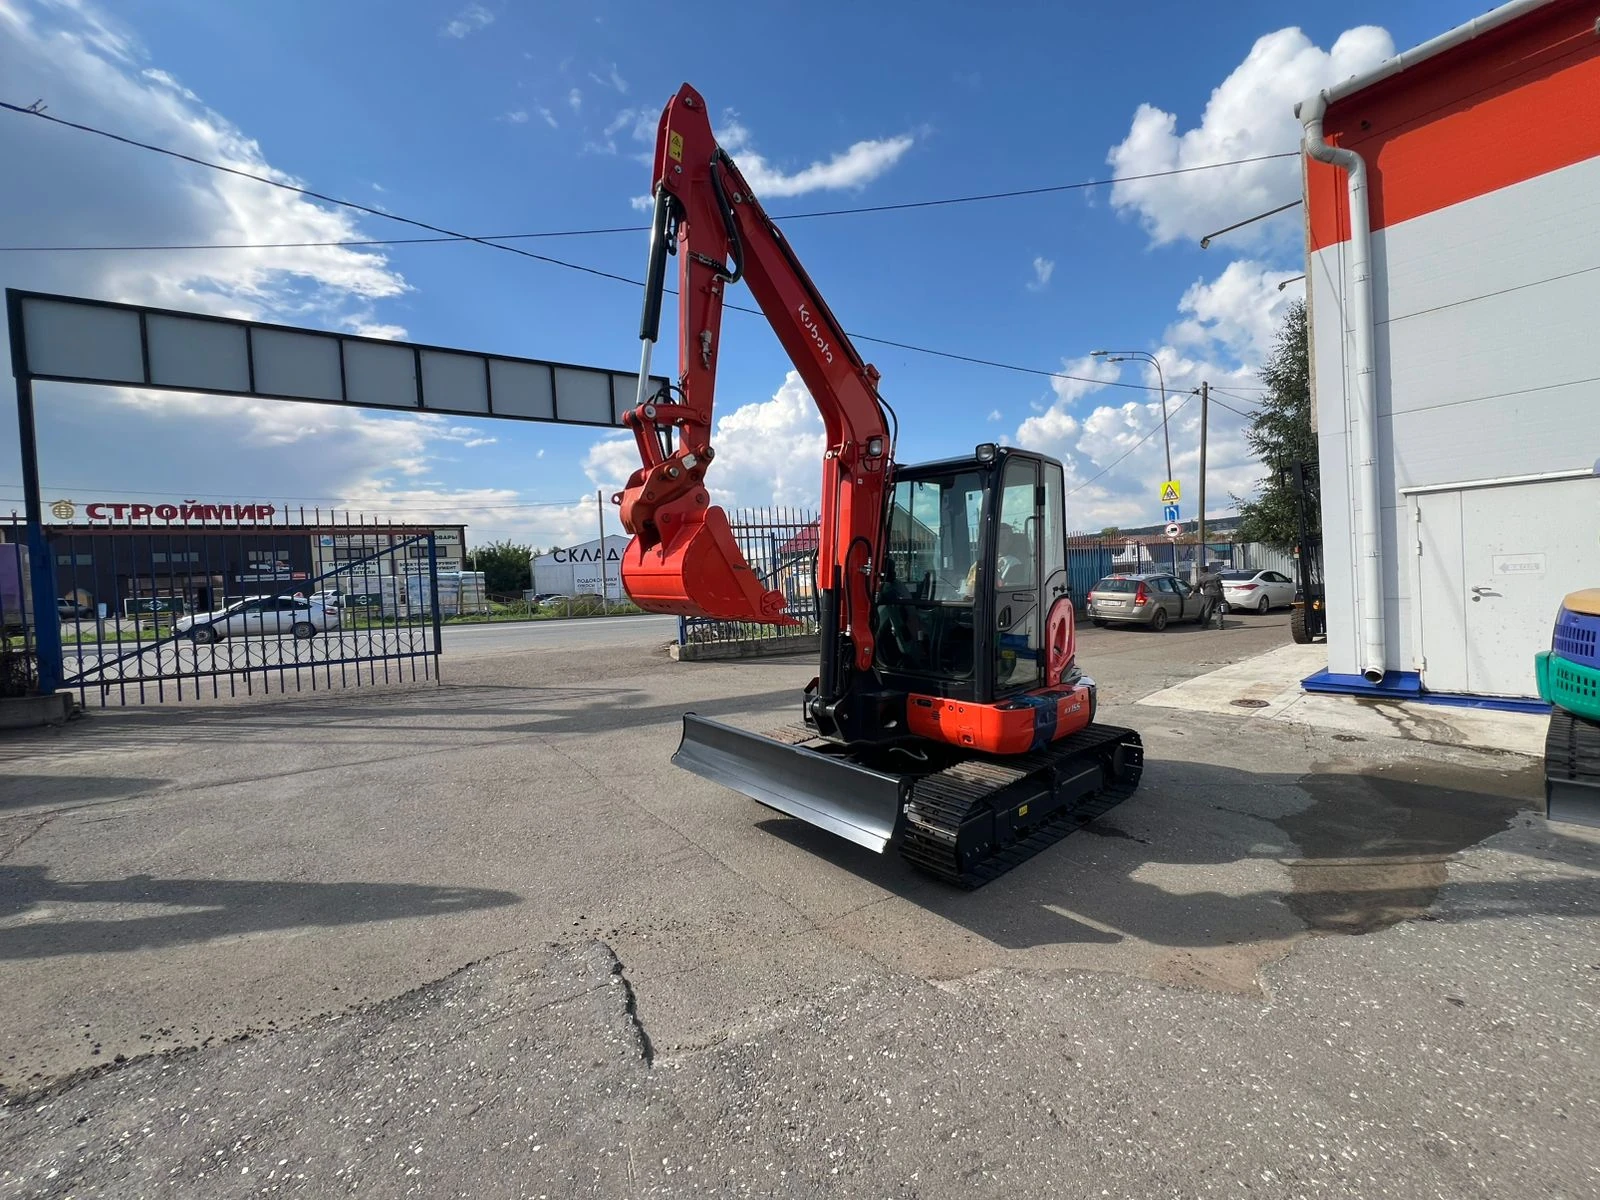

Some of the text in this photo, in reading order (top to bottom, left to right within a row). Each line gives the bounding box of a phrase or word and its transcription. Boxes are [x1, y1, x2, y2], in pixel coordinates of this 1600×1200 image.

[798, 303, 833, 364] Kubota
[86, 499, 275, 520] СТРОЙМИР
[553, 547, 625, 563] СКЛАД
